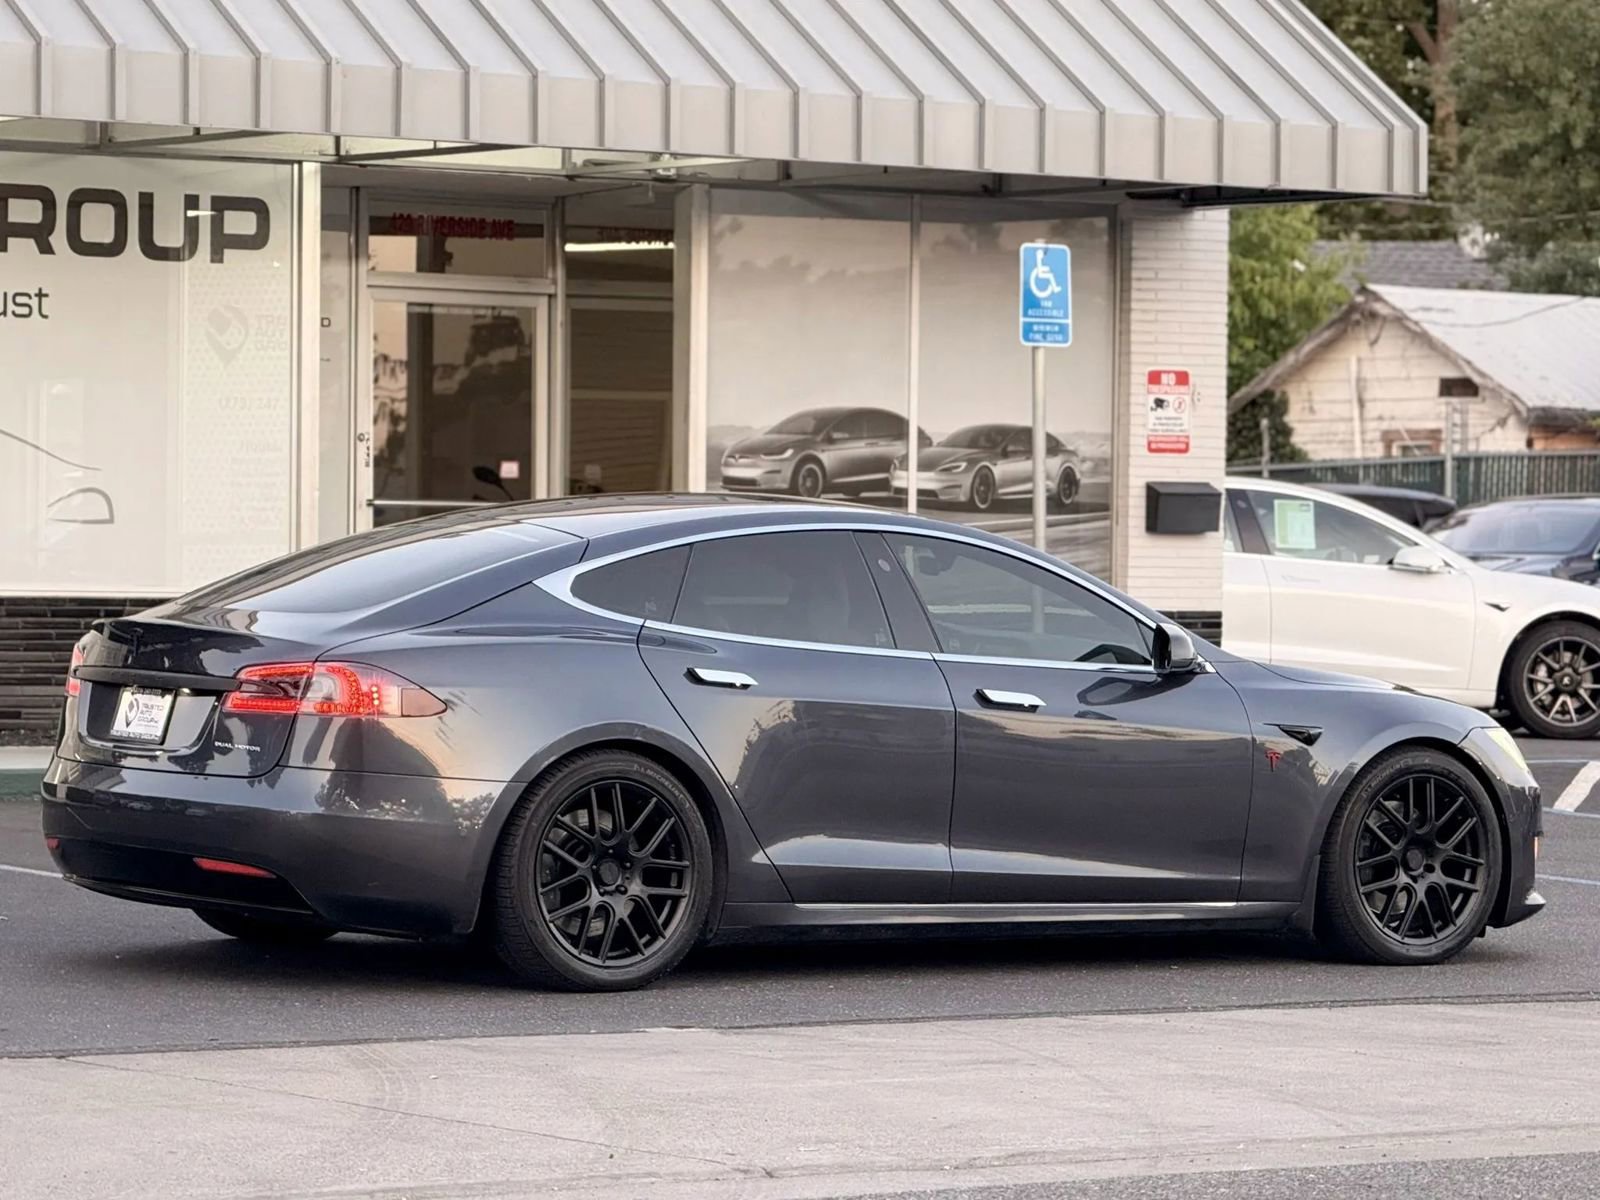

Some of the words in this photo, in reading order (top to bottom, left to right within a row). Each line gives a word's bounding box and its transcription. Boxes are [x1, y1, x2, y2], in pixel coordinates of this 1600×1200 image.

[490, 218, 515, 240] AVE
[1160, 372, 1176, 386] NO
[214, 741, 234, 749] DUAL
[234, 743, 261, 753] MOTOR
